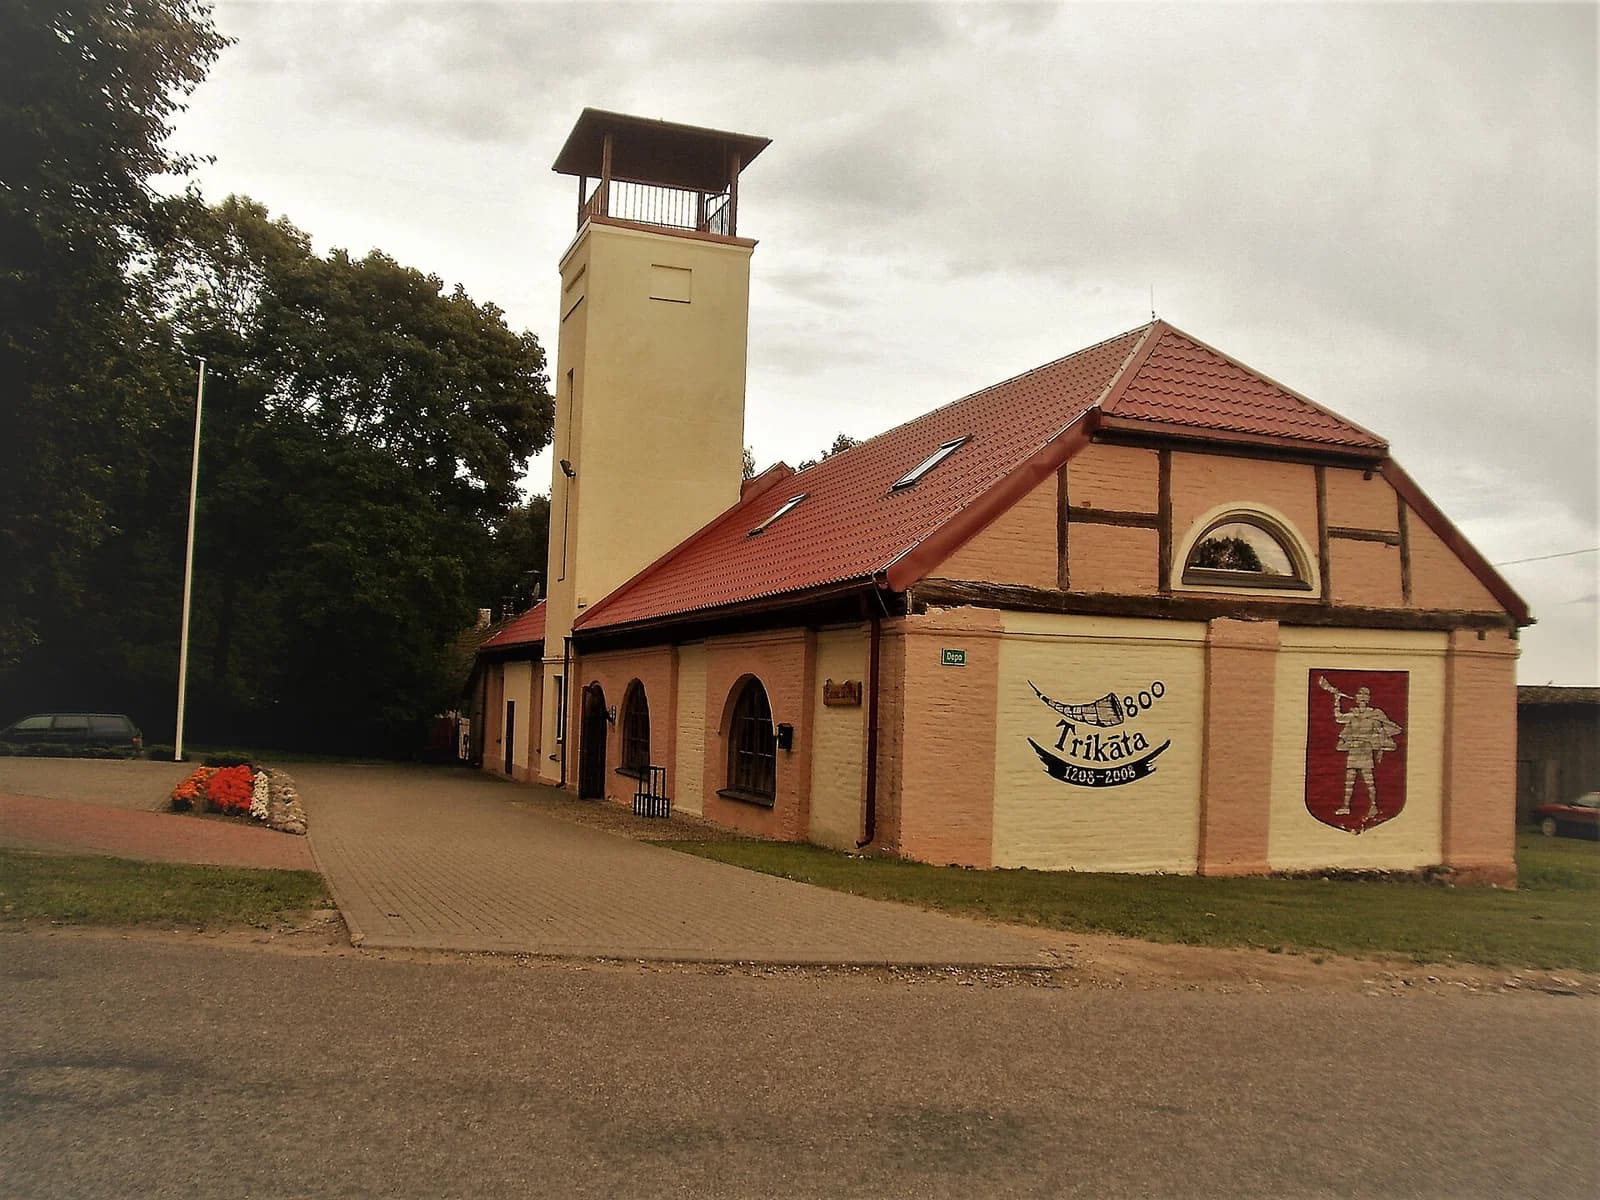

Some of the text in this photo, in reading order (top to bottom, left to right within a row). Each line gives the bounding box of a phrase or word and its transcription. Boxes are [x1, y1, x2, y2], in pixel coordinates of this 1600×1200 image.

[946, 651, 963, 663] Depo
[1123, 681, 1165, 717] 800
[1054, 719, 1150, 762] Trikāta
